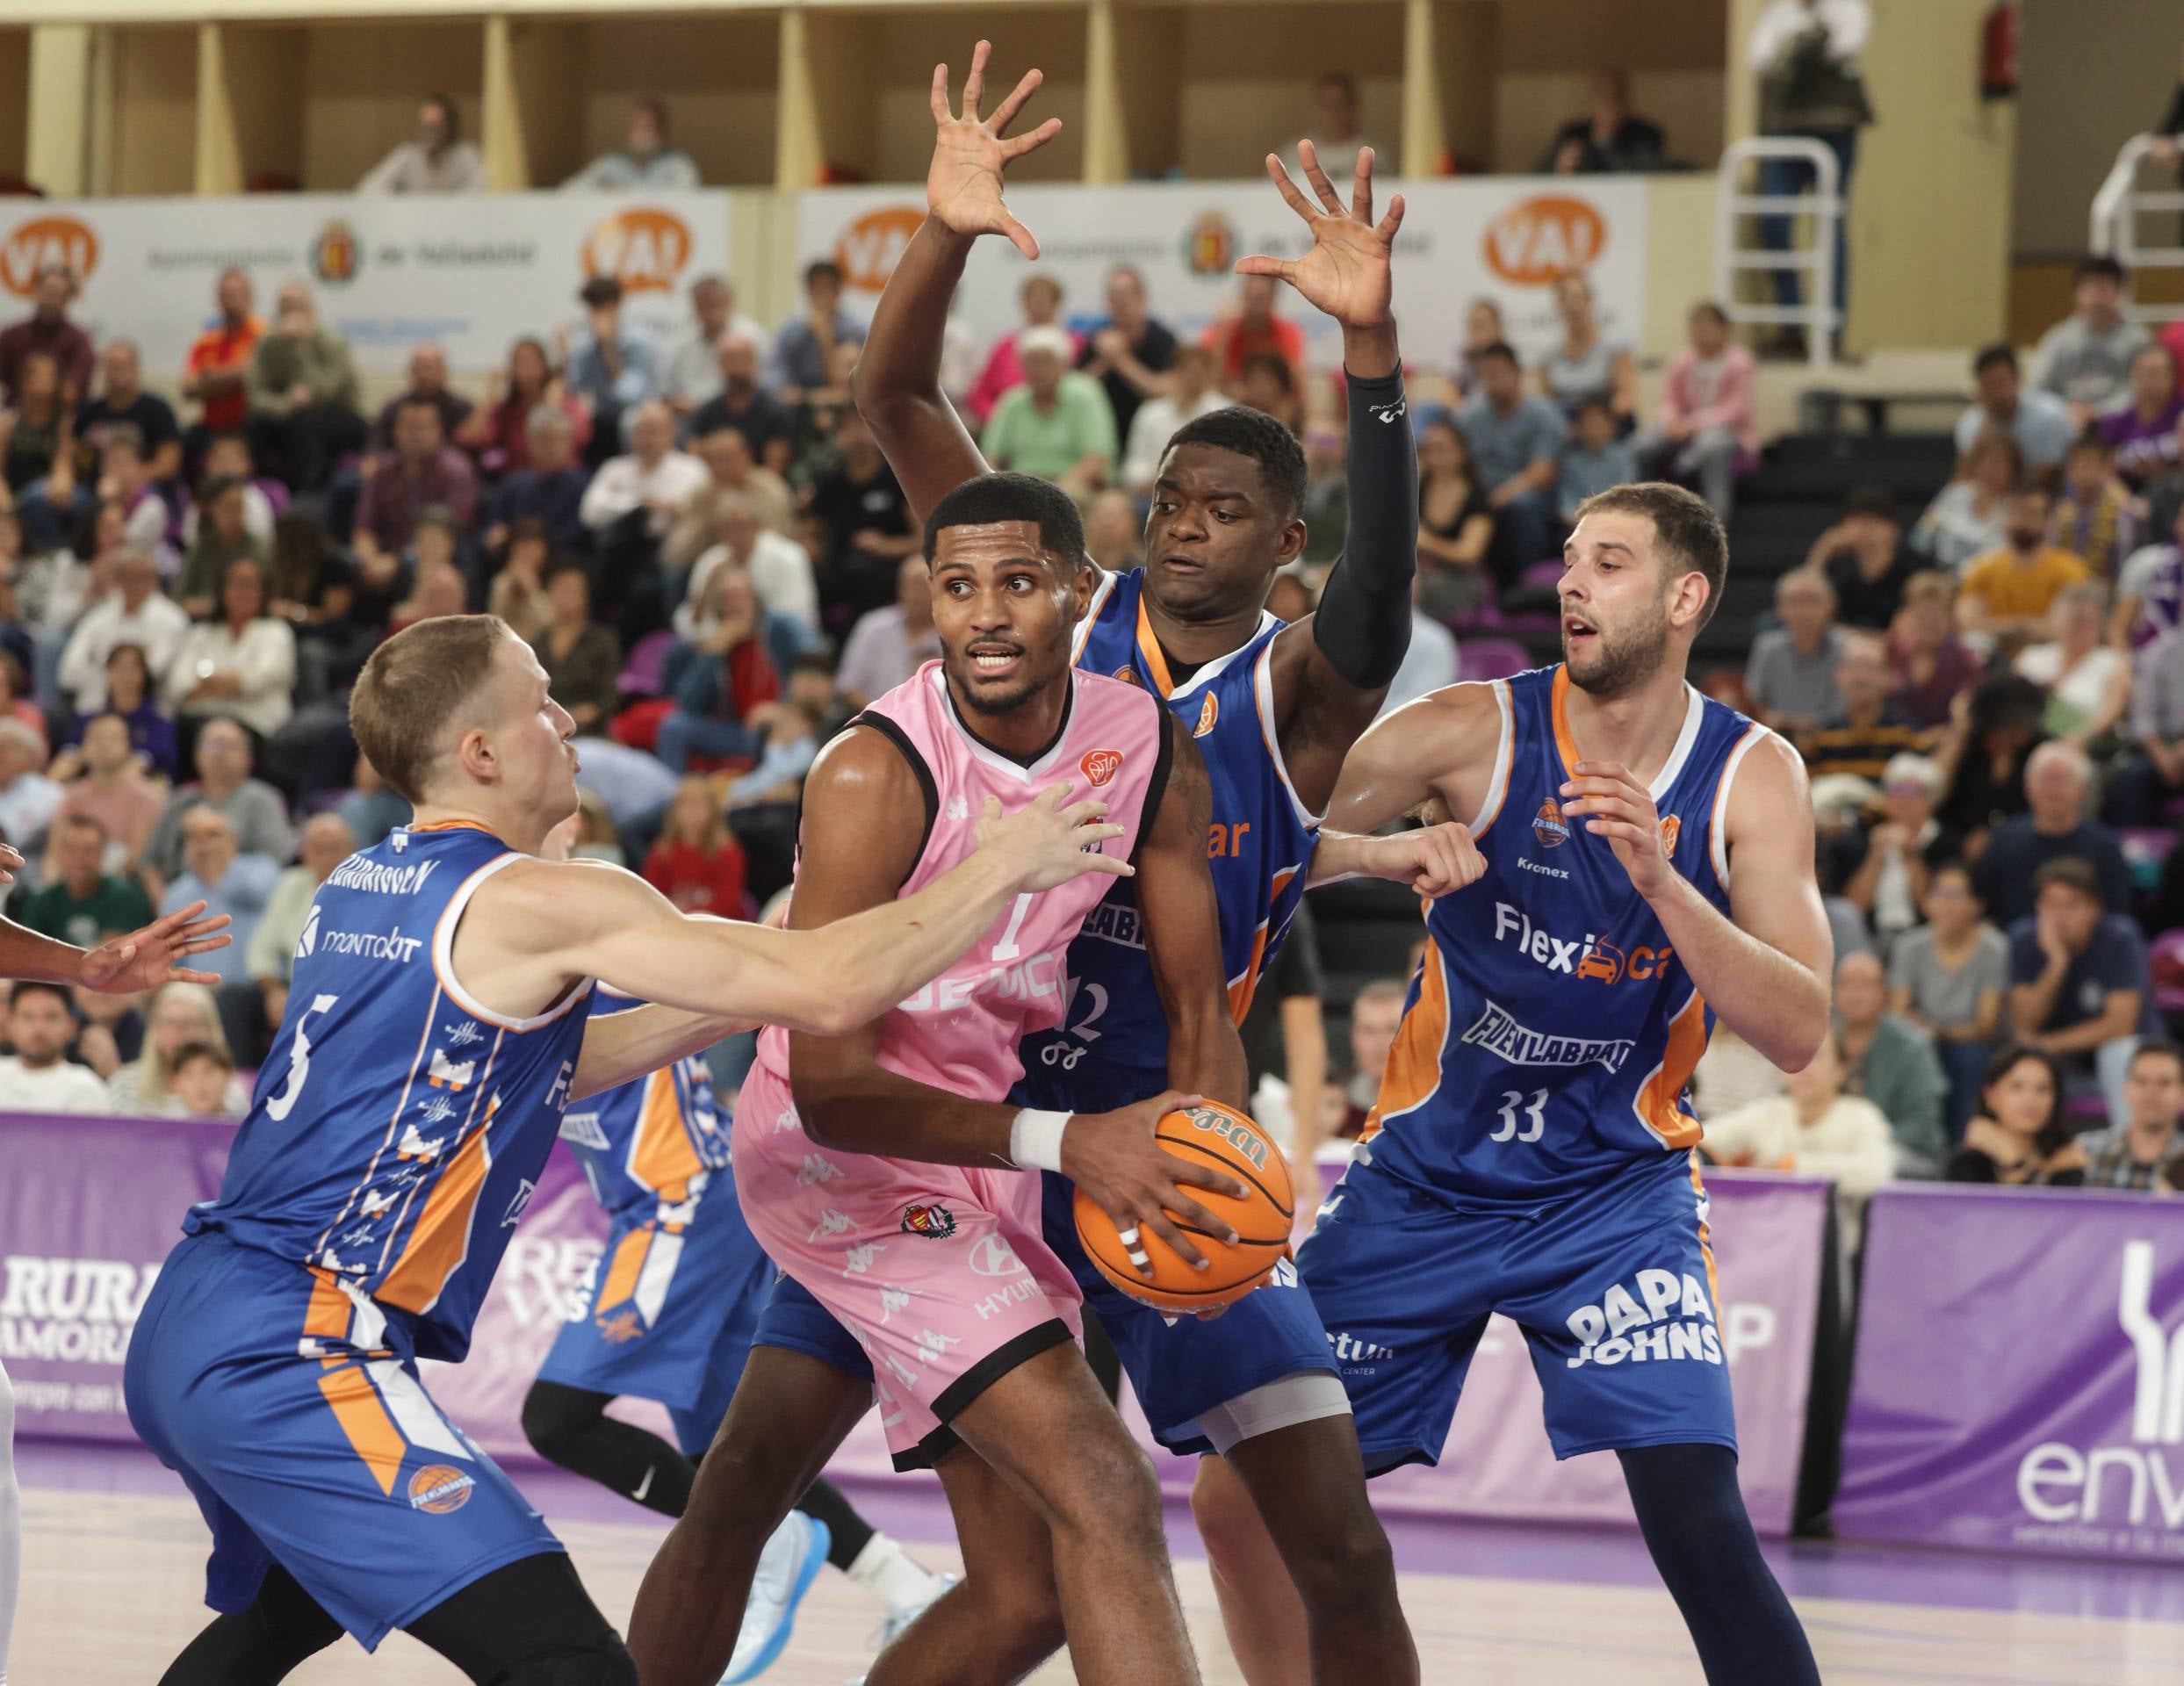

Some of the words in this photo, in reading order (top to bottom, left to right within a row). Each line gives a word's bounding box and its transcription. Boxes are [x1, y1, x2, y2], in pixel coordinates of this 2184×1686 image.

[1207, 822, 1251, 859] ar
[265, 993, 340, 1122] 5
[1489, 1087, 1549, 1142] 33
[1565, 1268, 1715, 1346] PAPA
[1567, 1322, 1722, 1369] JOHNS
